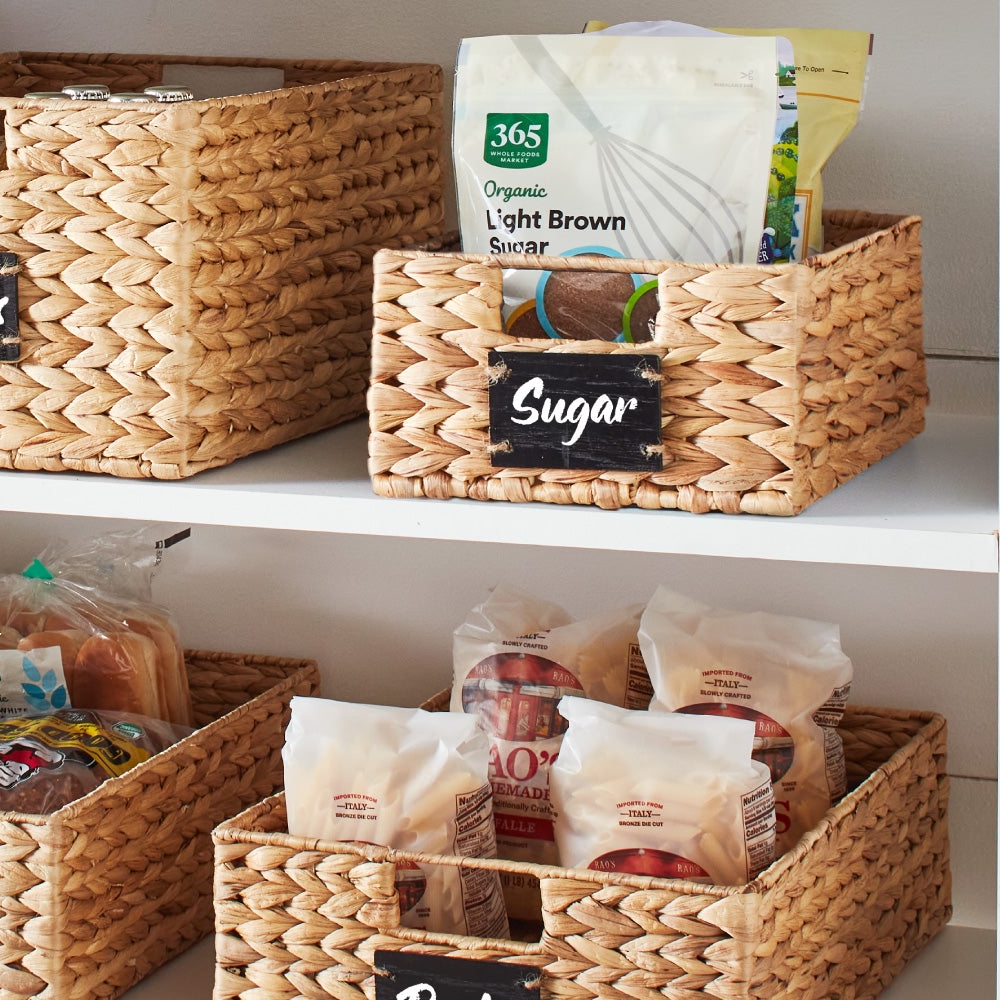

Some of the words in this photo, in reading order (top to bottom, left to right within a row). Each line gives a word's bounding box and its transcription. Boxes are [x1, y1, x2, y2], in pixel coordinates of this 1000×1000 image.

[810, 66, 825, 74] Open
[490, 120, 542, 149] 365
[490, 150, 515, 158] WHOLE
[516, 150, 540, 158] FOODS
[484, 179, 548, 203] Organic
[486, 207, 542, 234] Light
[548, 209, 626, 231] Brown
[489, 236, 550, 255] Sugar
[510, 376, 638, 447] Sugar
[502, 640, 523, 649] SLOWLY
[523, 641, 549, 650] CRAFTED
[552, 671, 576, 685] RAO'S
[702, 669, 734, 677] IMPORTED
[735, 671, 753, 681] FROM
[714, 679, 740, 689] ITALY
[700, 689, 724, 697] SLOWLY
[724, 691, 752, 700] CRAFTED
[758, 721, 783, 736] RAO'S
[488, 743, 560, 782] AO'
[333, 793, 362, 801] IMPORTED
[362, 795, 378, 803] FROM
[743, 788, 770, 807] Nutrition
[345, 802, 368, 811] ITALY
[616, 800, 646, 809] IMPORTED
[646, 801, 664, 809] FROM
[628, 809, 653, 818] ITALY
[458, 815, 483, 833] Calories
[745, 821, 769, 838] Calories
[594, 859, 616, 870] RAO'S
[677, 863, 700, 874] RAO'S
